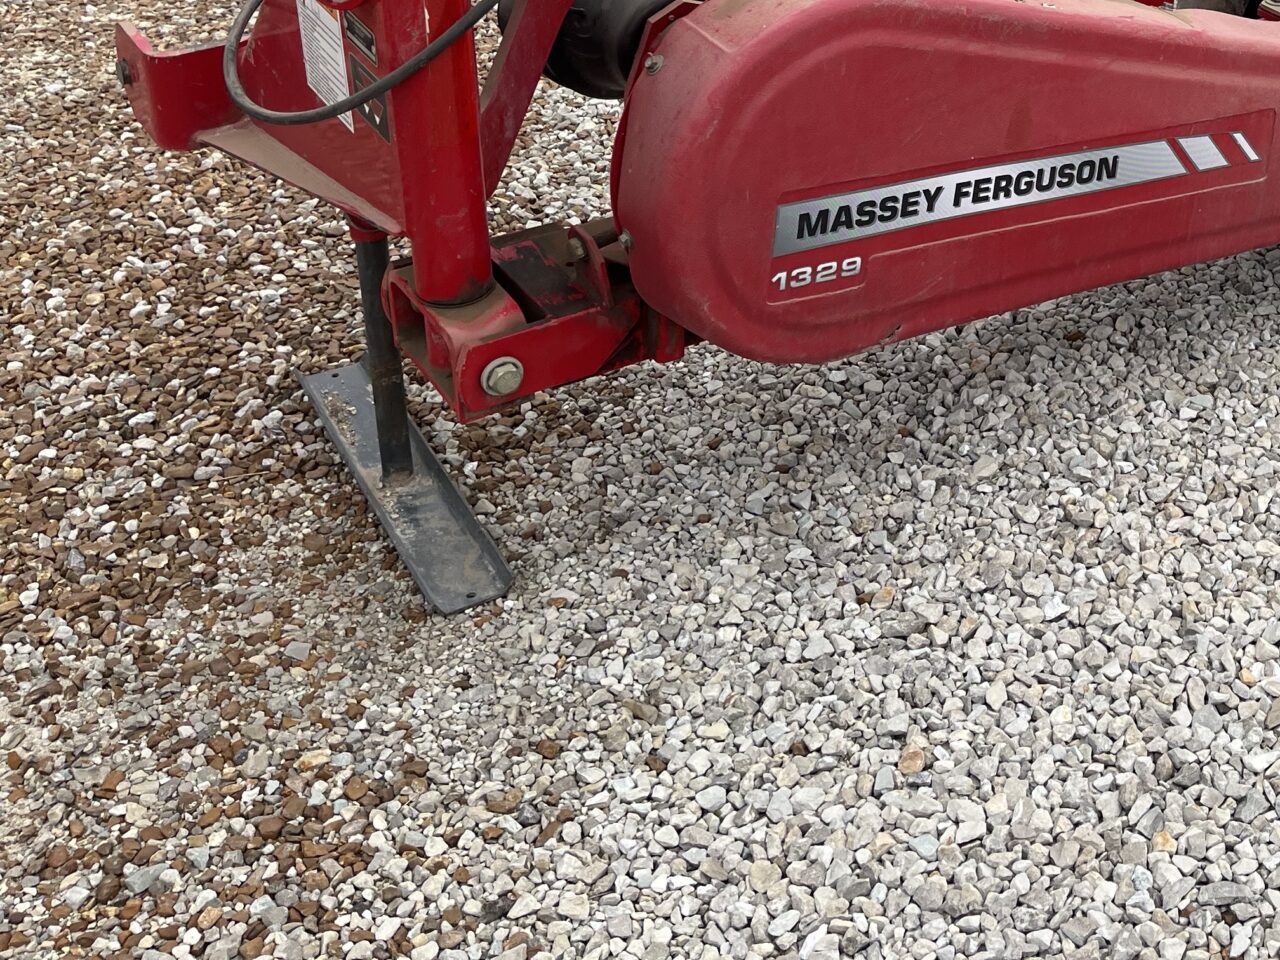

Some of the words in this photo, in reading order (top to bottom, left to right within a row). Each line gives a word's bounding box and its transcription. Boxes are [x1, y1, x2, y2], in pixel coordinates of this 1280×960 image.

[796, 186, 945, 240] MASSEY
[952, 155, 1120, 209] FERGUSON
[771, 256, 862, 291] 1329
